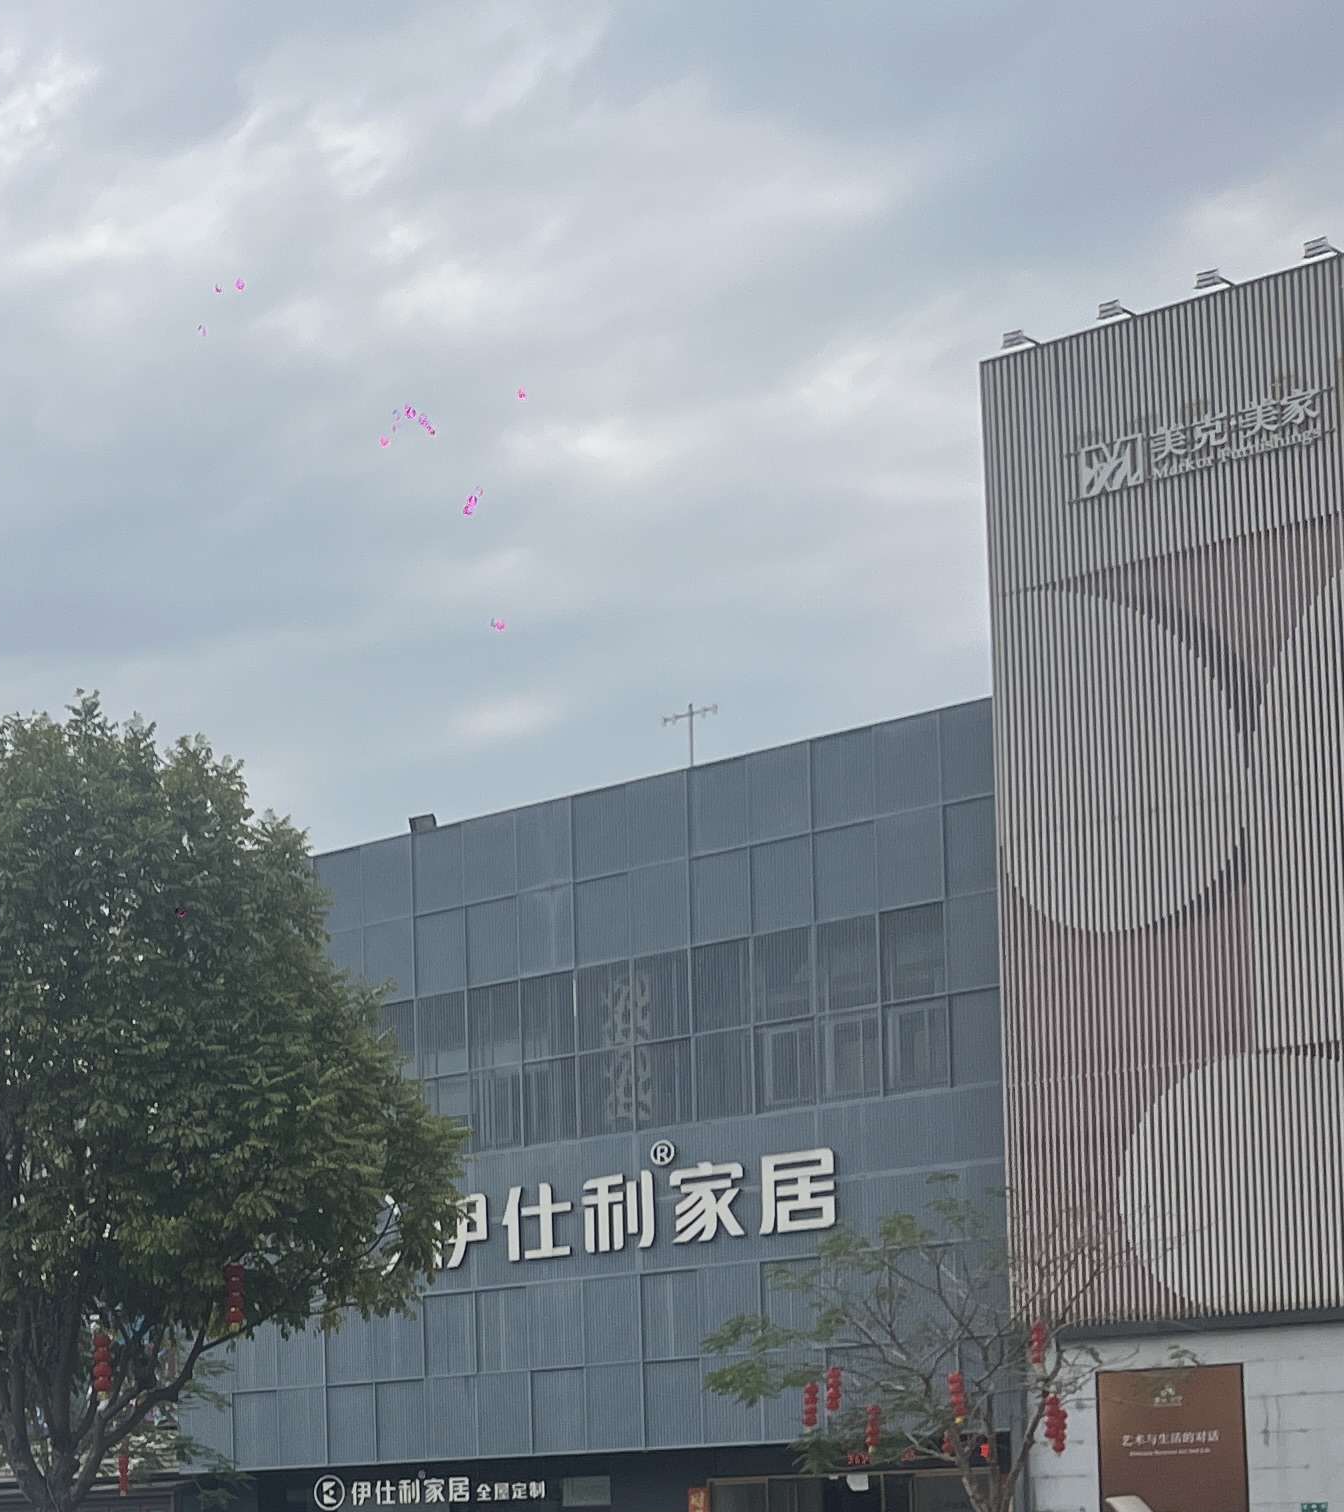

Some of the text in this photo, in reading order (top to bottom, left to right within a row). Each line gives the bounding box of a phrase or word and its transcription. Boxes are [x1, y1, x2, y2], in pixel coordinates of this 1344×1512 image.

[1150, 387, 1322, 461] 美克·美家
[350, 1476, 471, 1506] 伊仕利家居
